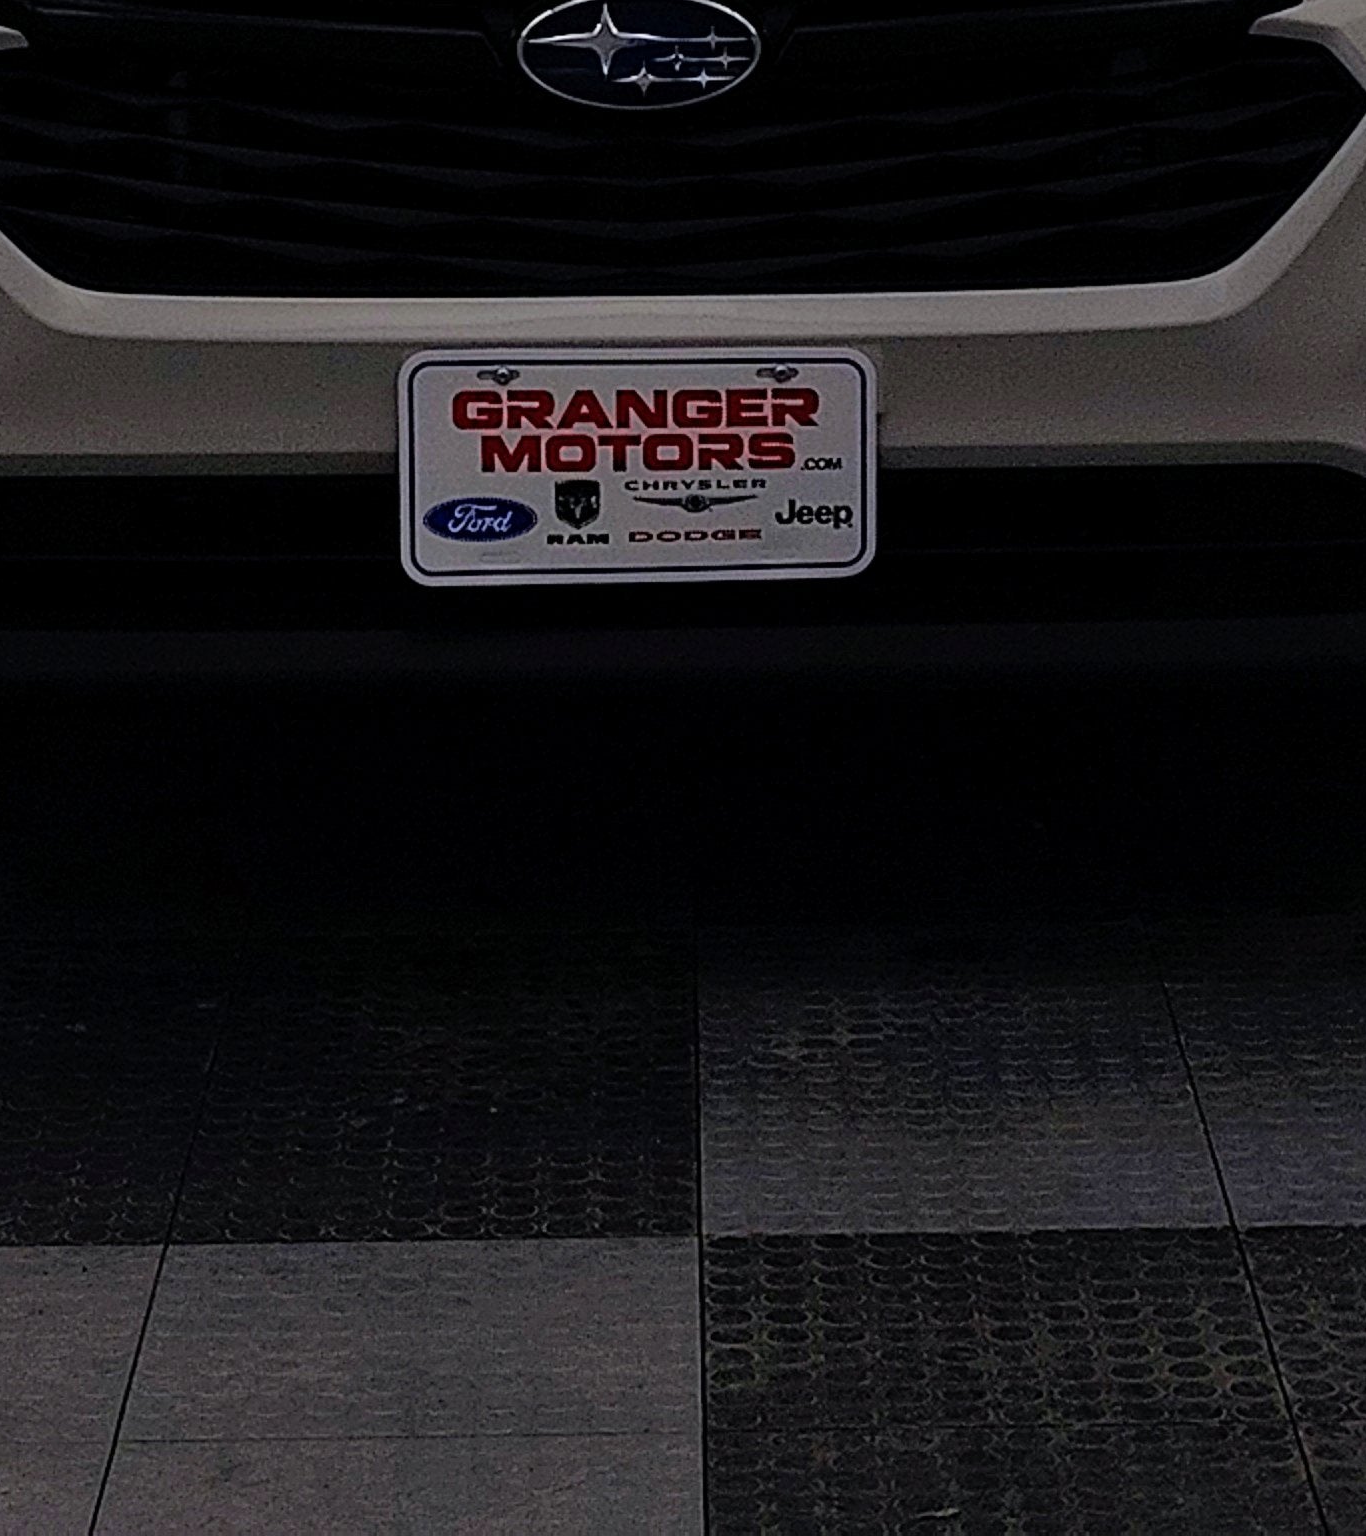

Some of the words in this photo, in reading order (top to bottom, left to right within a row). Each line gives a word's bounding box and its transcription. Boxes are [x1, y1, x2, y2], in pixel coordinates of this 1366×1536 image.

[452, 389, 819, 429] GRANGER
[481, 433, 795, 472] MOTORS
[624, 478, 767, 491] CHRYSLER
[447, 504, 512, 534] Ford
[775, 499, 853, 529] Jeep
[546, 534, 610, 545] RAM
[628, 529, 762, 542] DODGE
